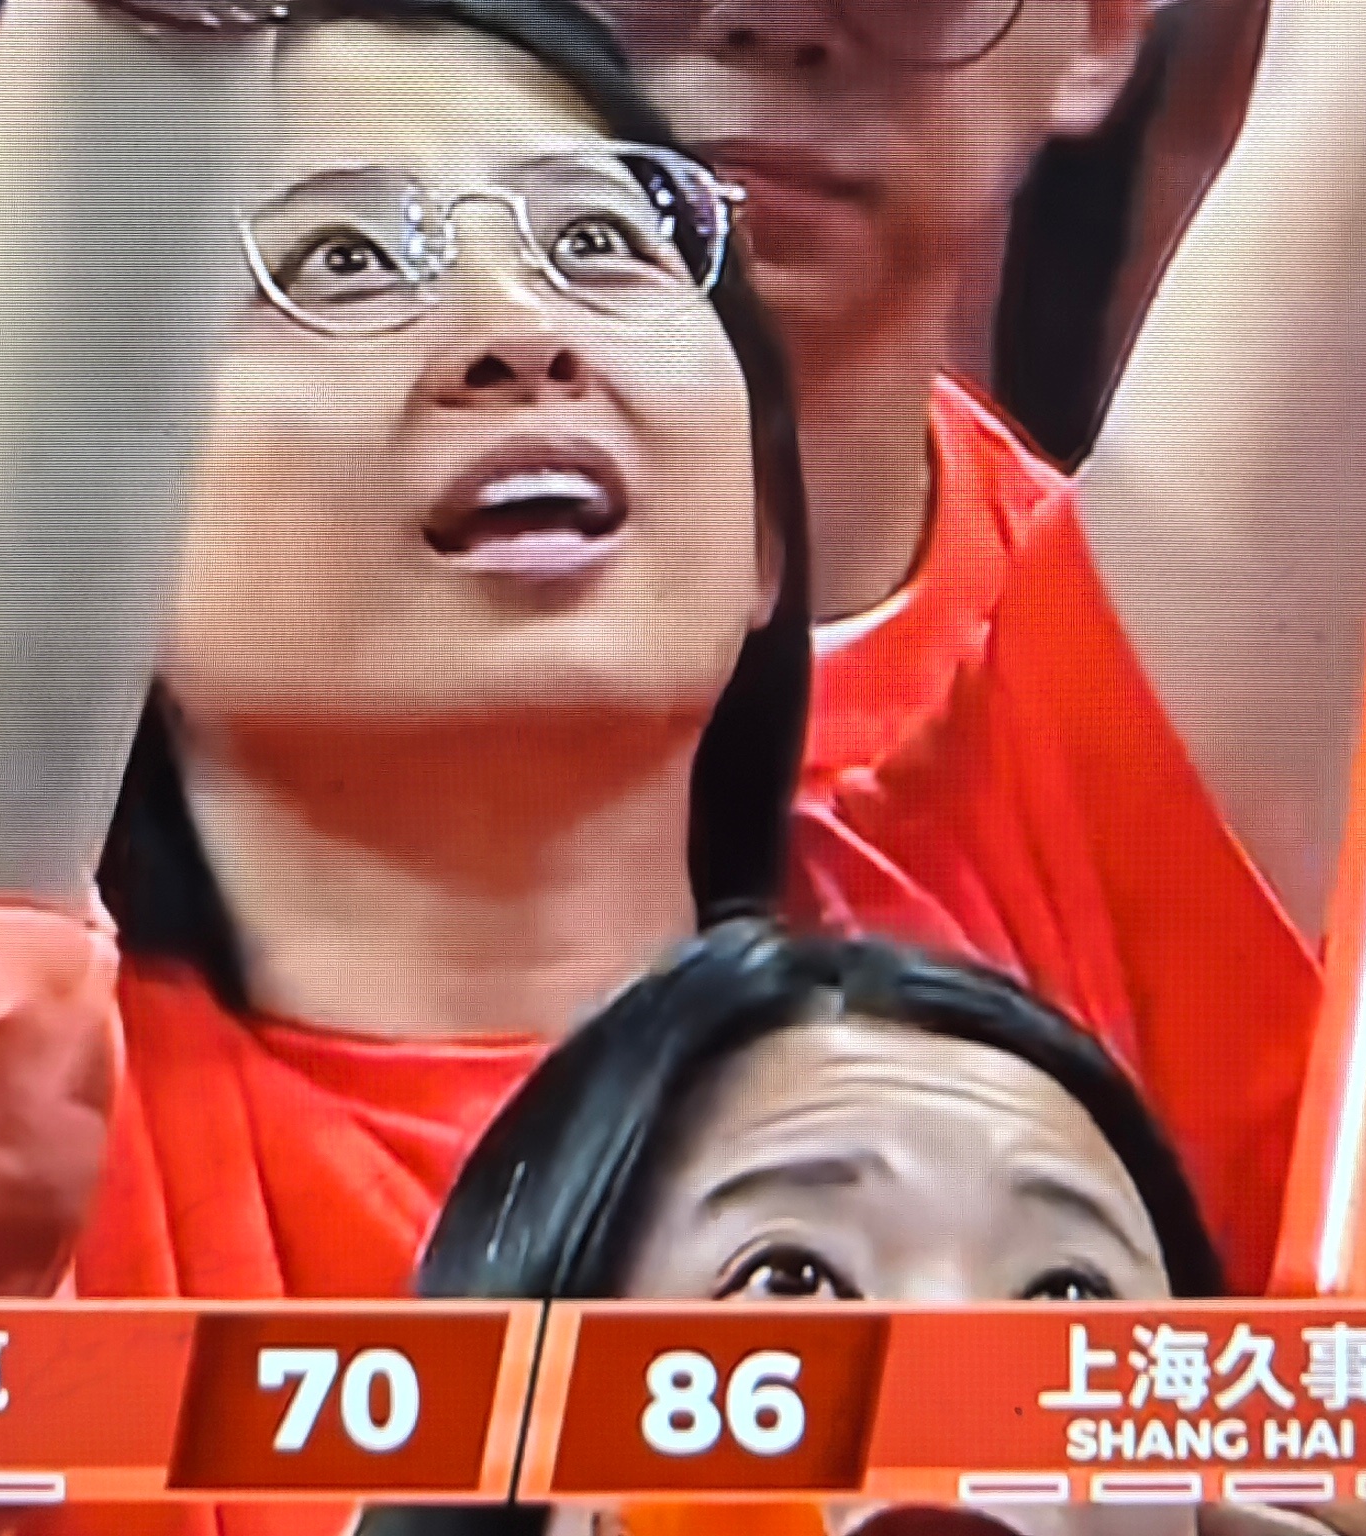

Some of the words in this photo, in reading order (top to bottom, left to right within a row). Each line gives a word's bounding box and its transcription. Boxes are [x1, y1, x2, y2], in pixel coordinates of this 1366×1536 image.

[257, 1348, 420, 1452] 70
[641, 1351, 806, 1456] 86
[1066, 1417, 1250, 1462] SHANG
[1264, 1417, 1356, 1461] HAI
